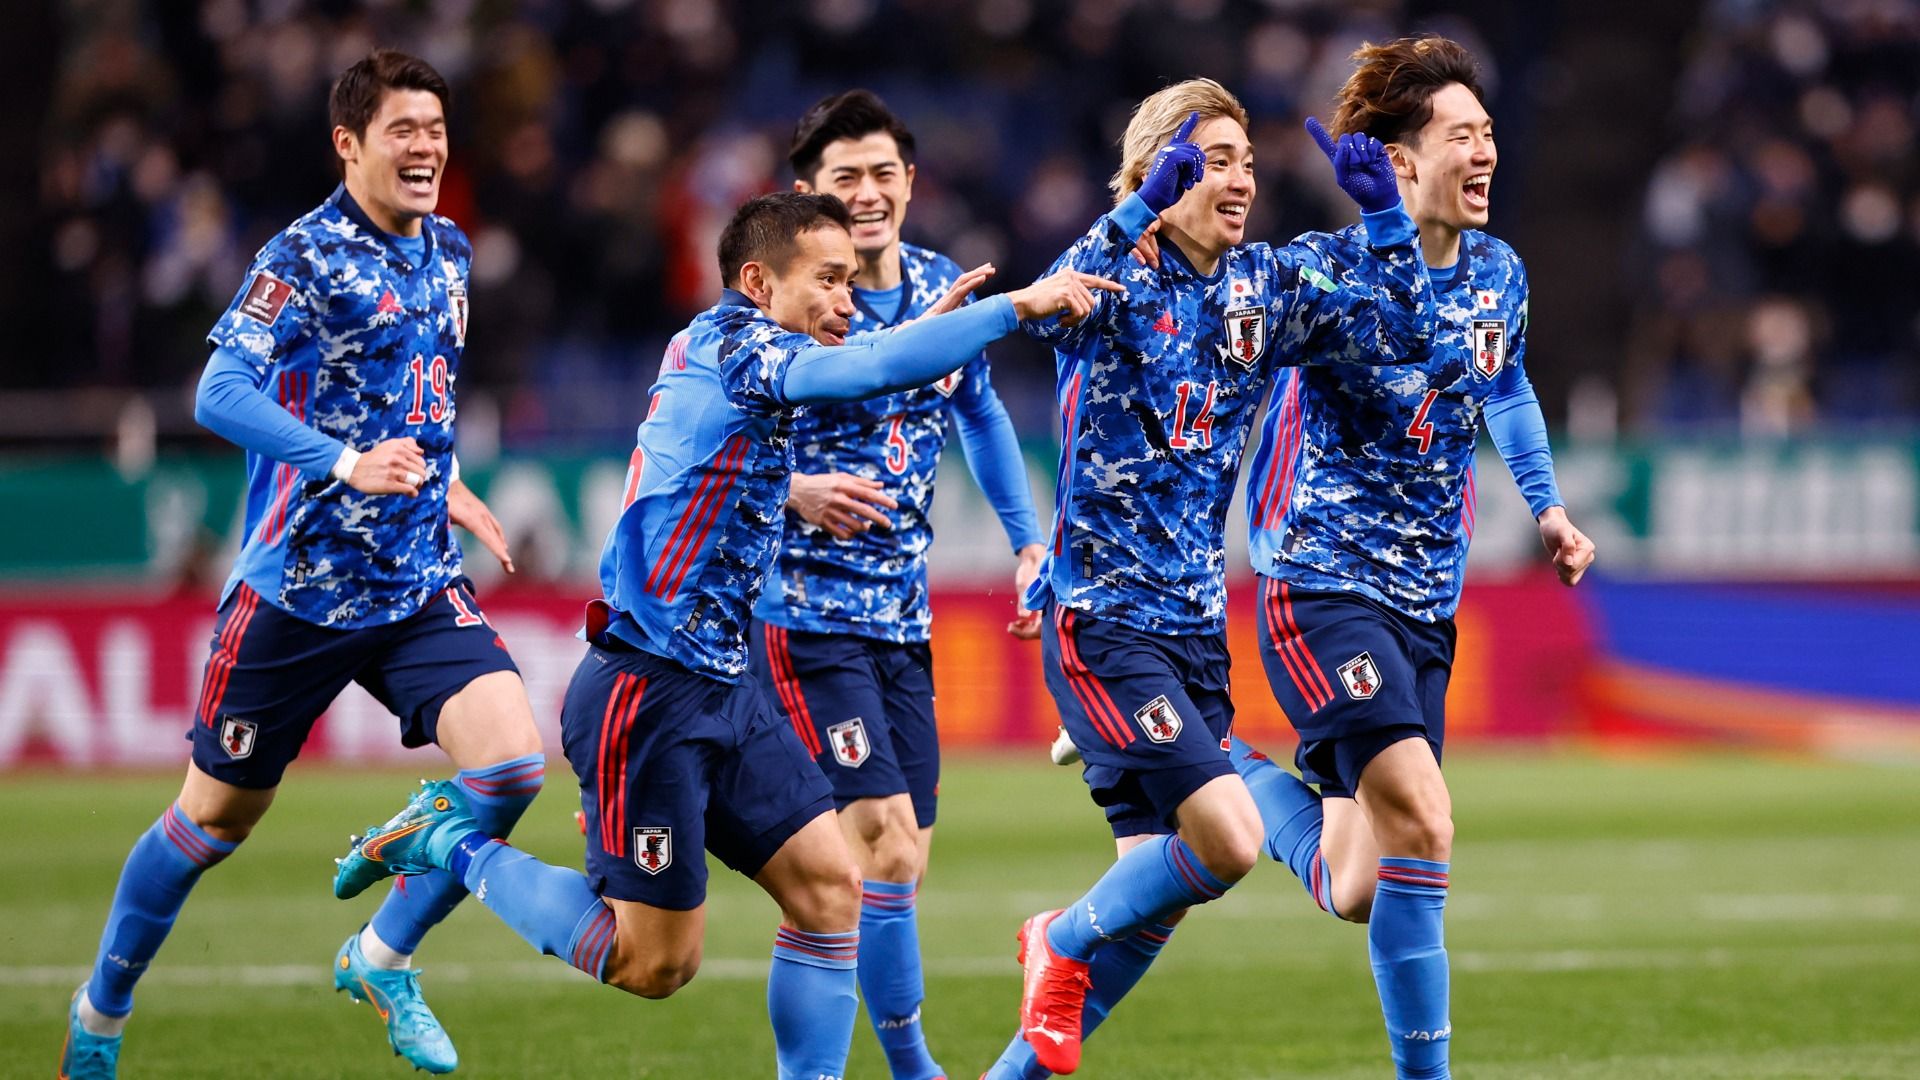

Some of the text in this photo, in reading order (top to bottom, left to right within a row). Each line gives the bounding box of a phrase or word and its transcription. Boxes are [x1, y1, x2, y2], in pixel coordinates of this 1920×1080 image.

[1234, 309, 1256, 317] JAPAN
[406, 354, 448, 425] 19
[1169, 381, 1216, 448] 14
[1407, 389, 1439, 456] 4
[885, 412, 908, 475] 3
